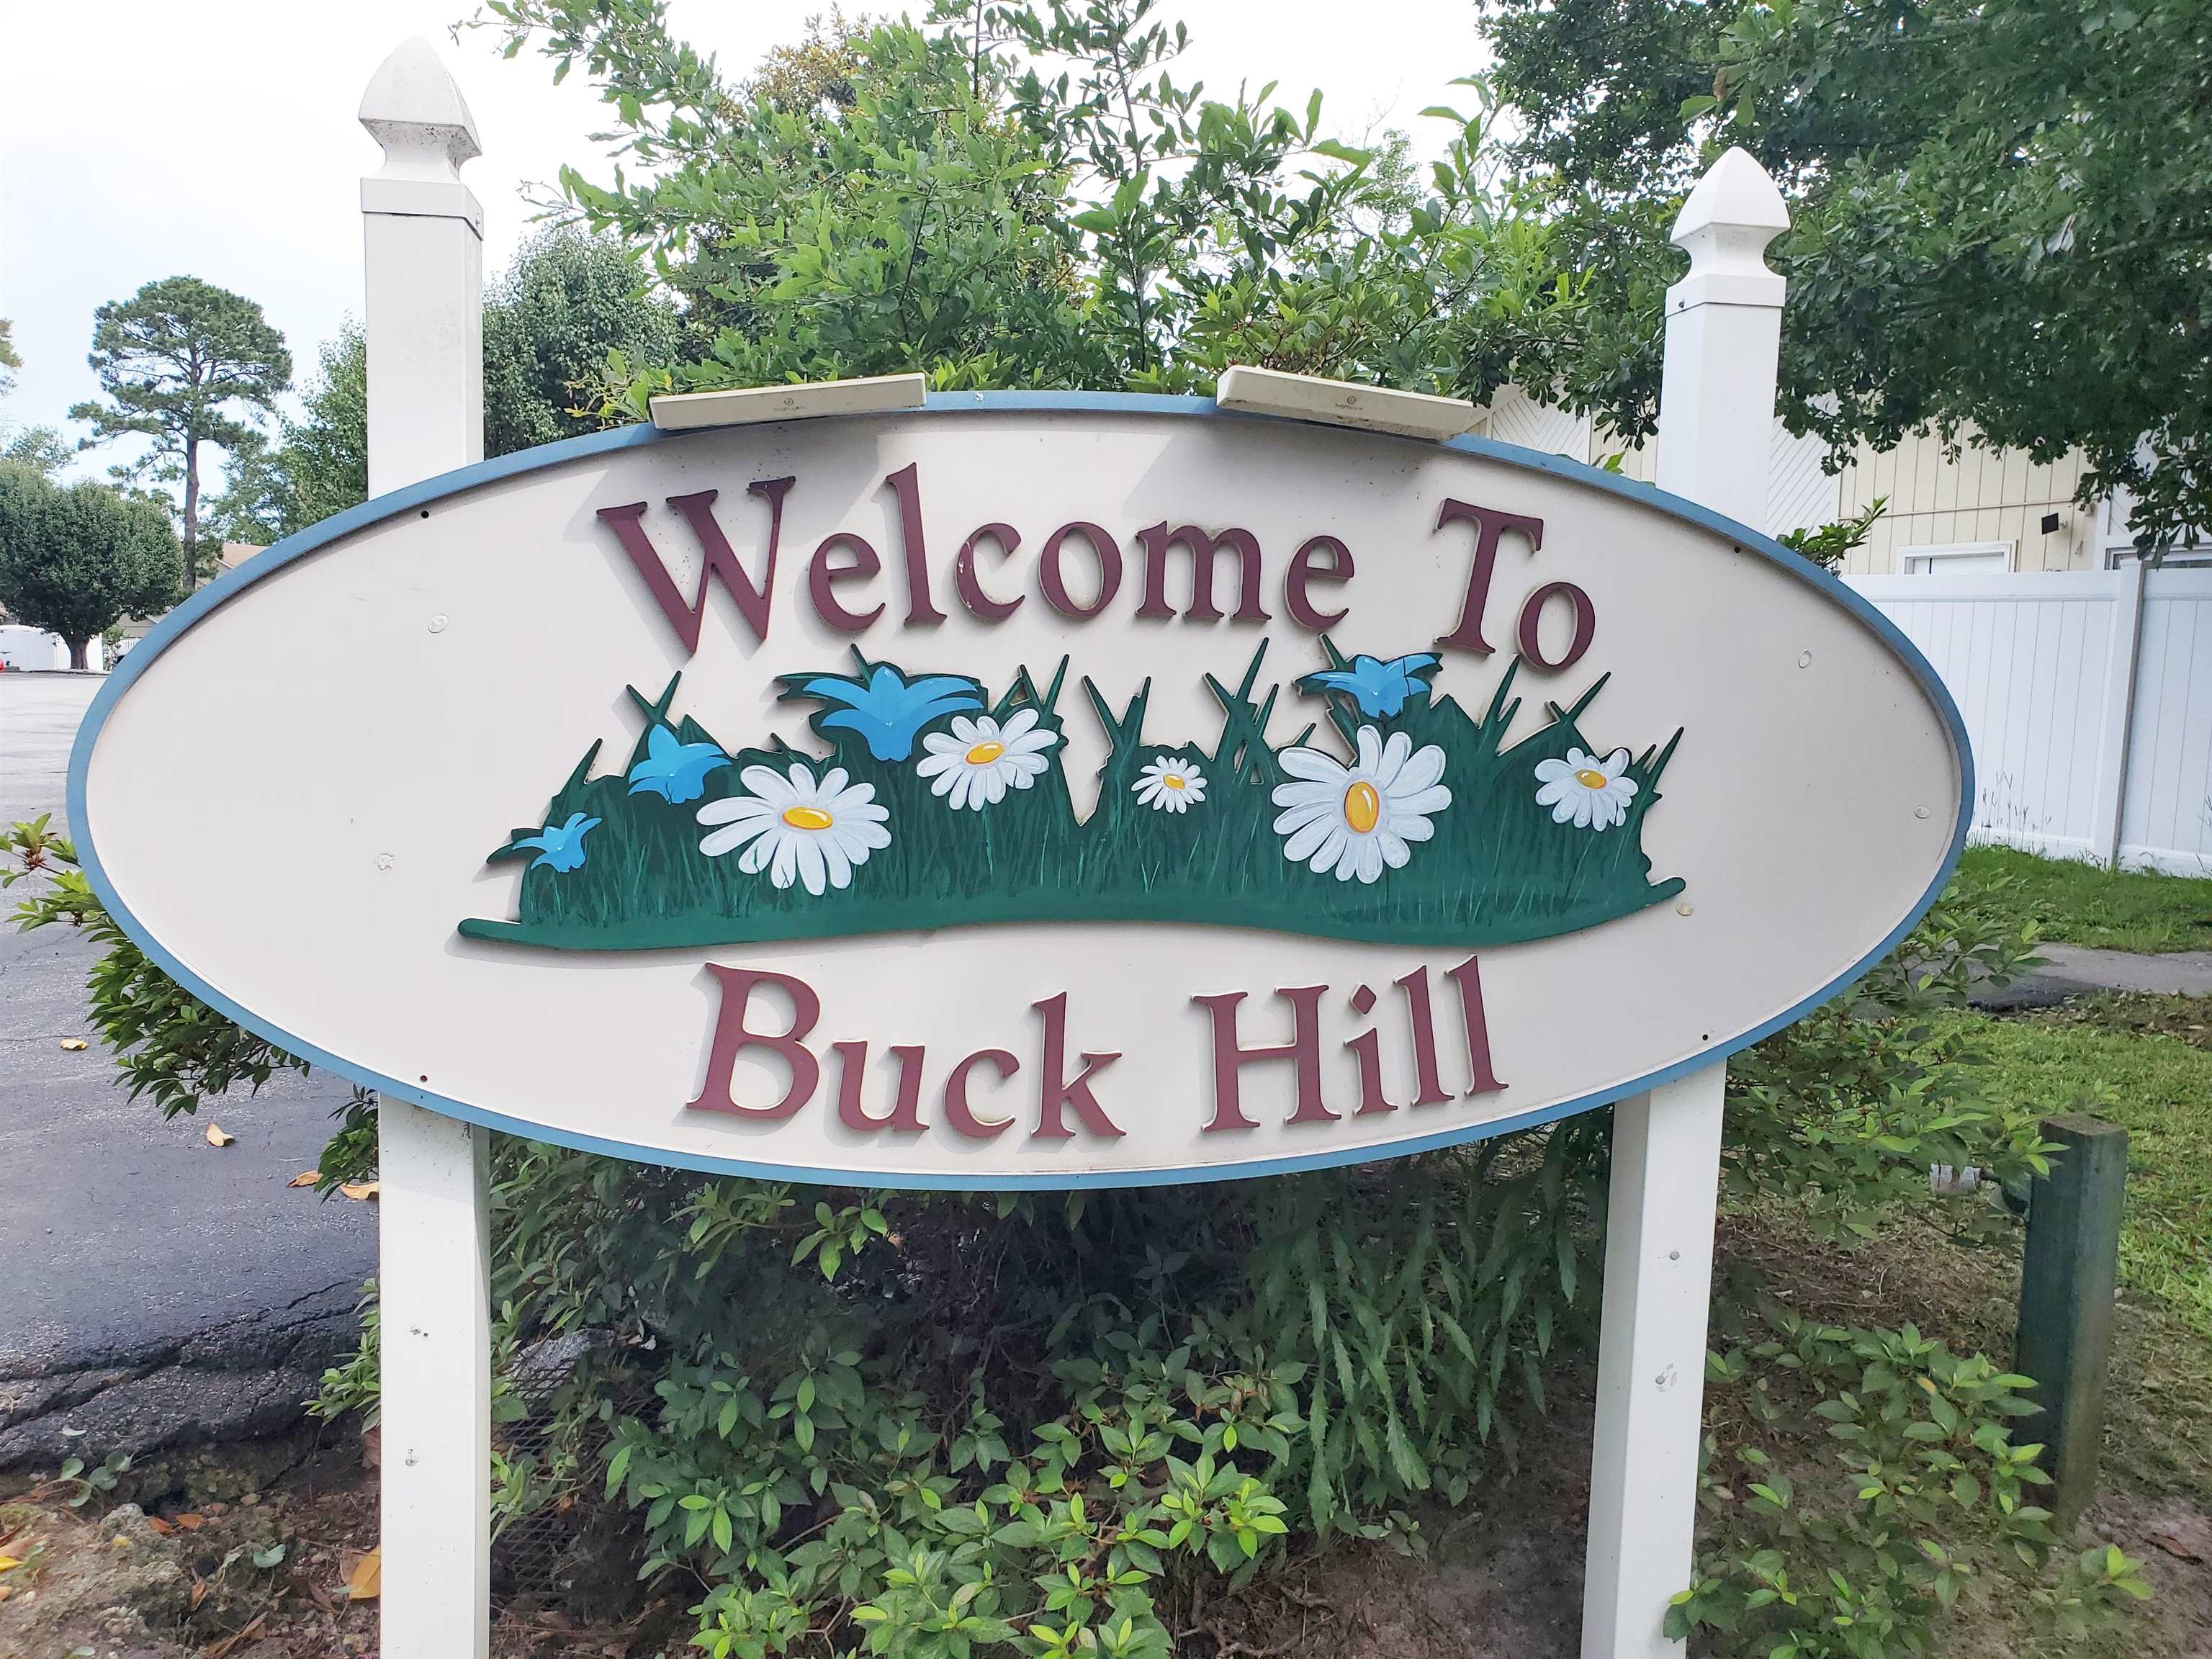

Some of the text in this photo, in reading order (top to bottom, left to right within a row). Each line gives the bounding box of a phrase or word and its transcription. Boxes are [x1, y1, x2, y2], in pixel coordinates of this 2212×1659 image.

[596, 462, 1596, 670] Welcome To
[687, 954, 1509, 1138] Buck Hill
